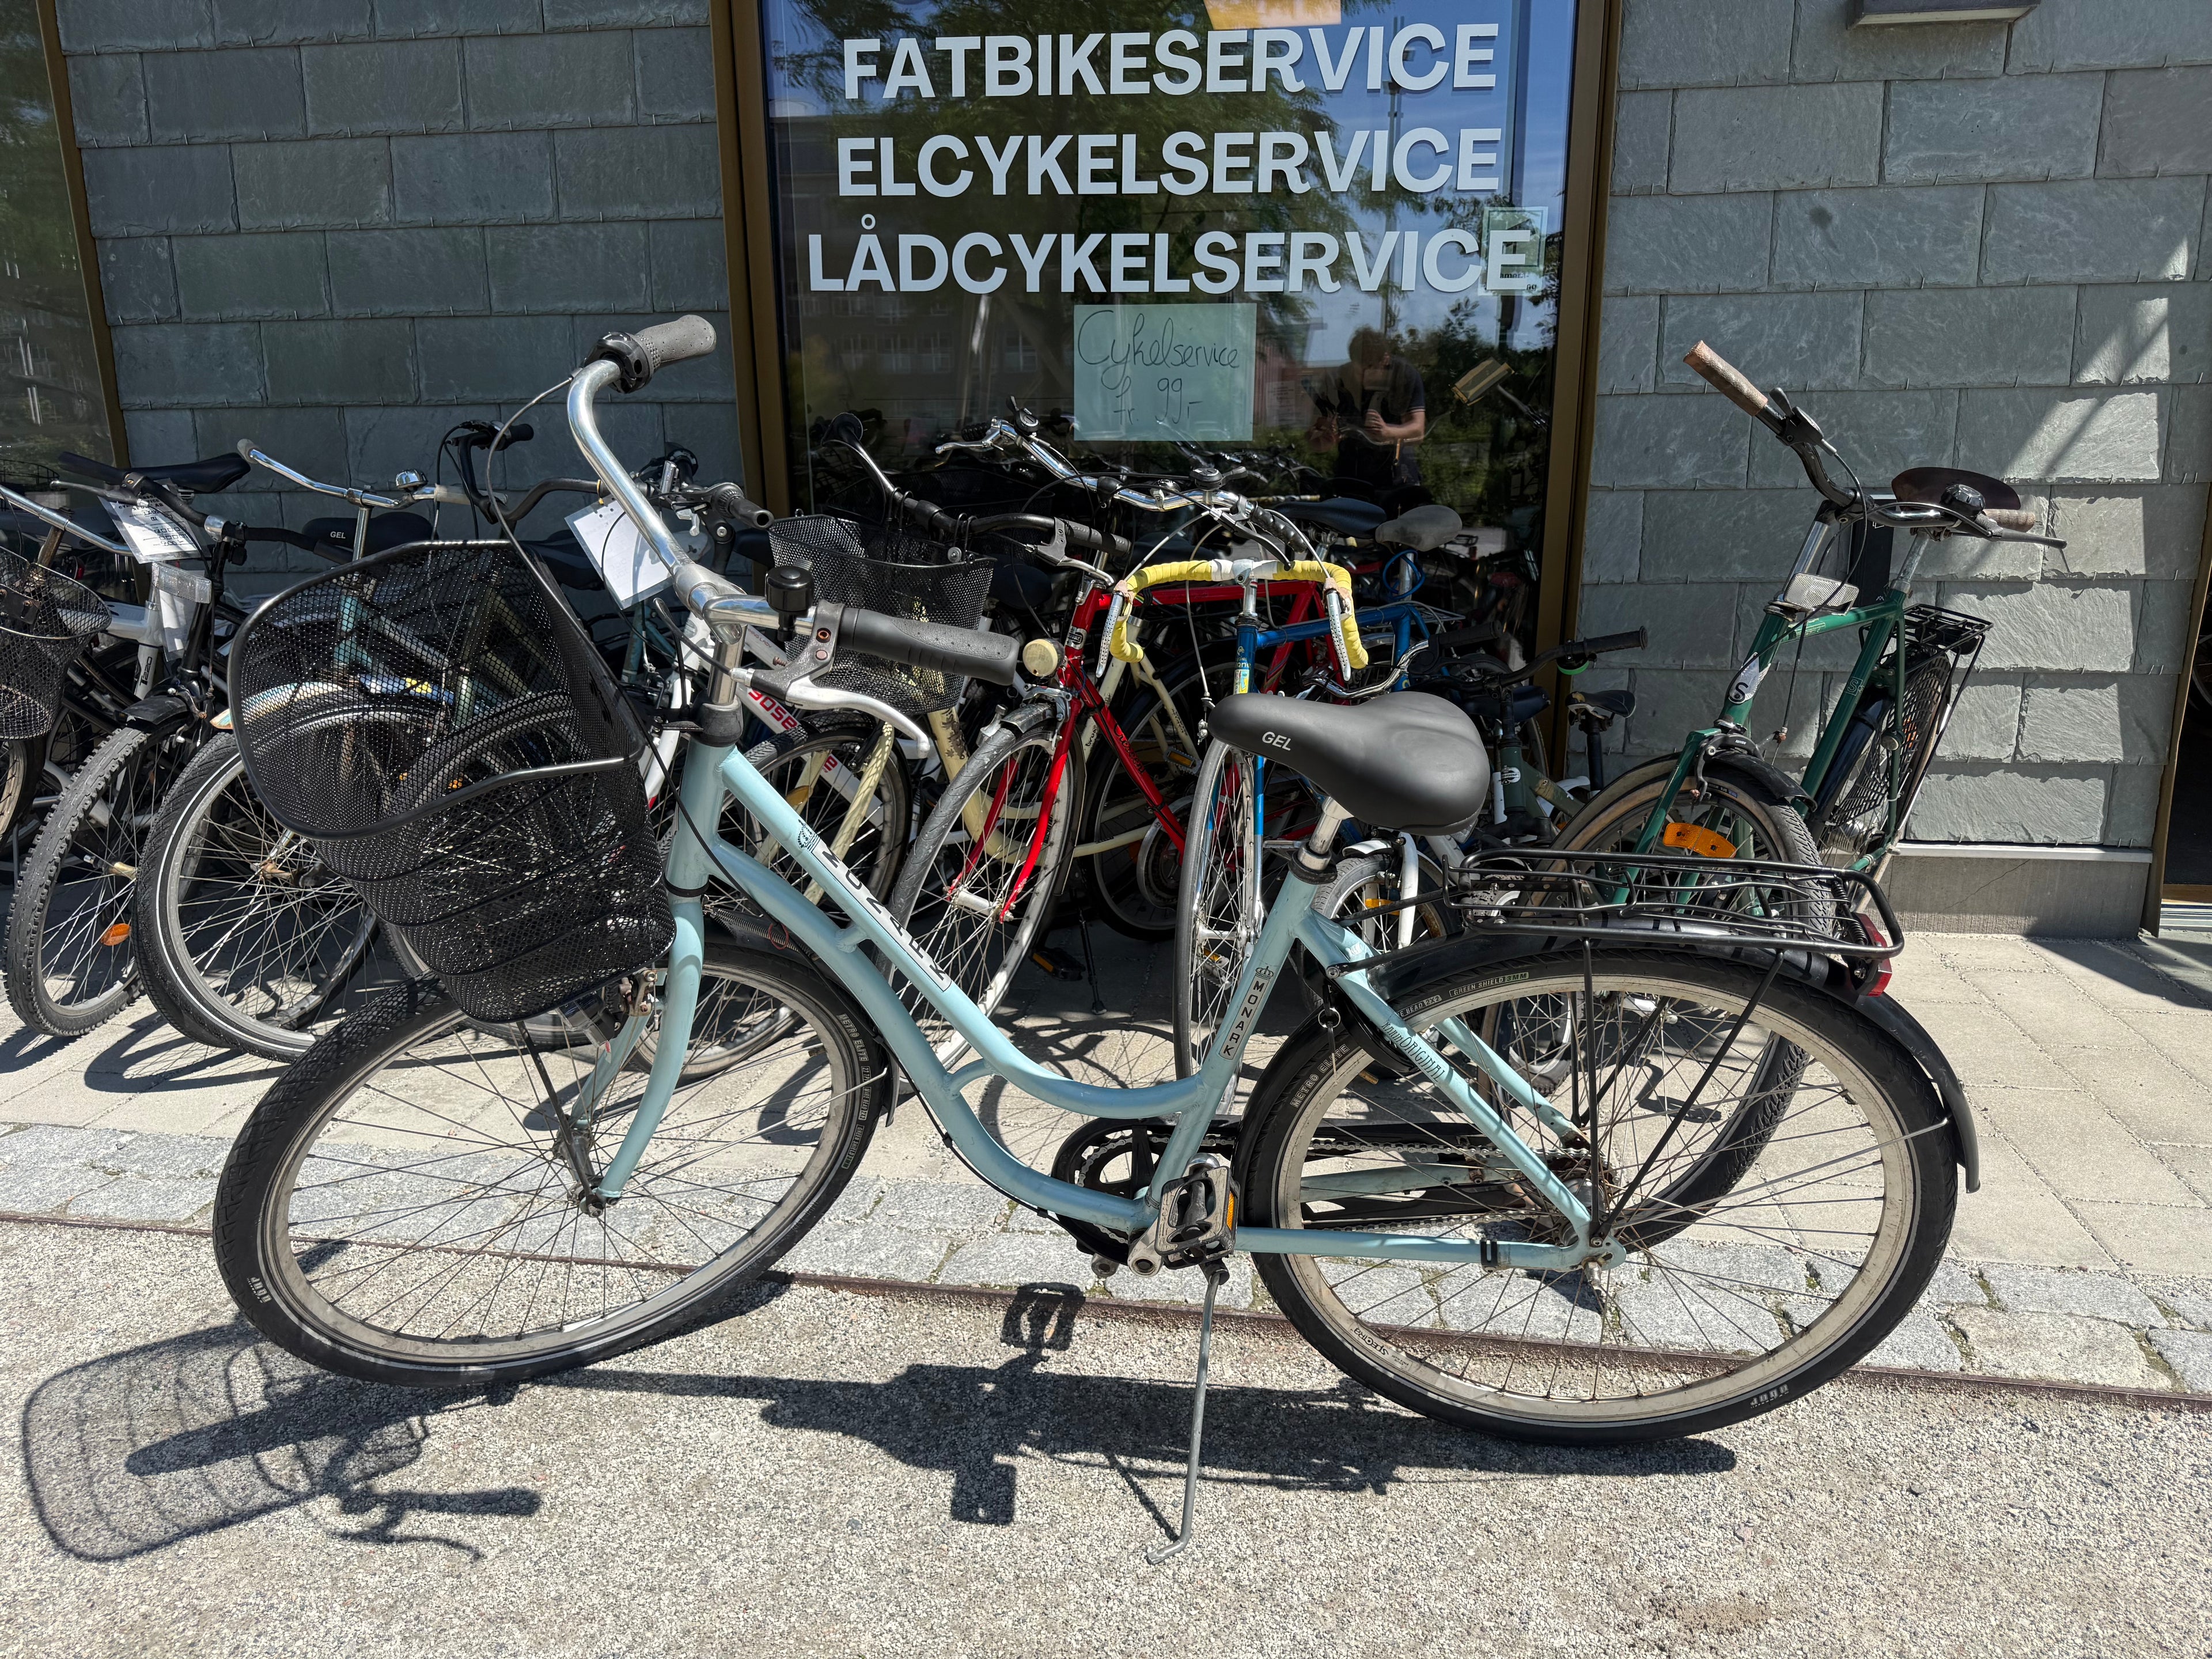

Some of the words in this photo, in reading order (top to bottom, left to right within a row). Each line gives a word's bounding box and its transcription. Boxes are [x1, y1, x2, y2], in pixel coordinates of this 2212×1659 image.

[843, 23, 1499, 100] FATBIKESERVICE
[838, 127, 1502, 198] ELCYKELSERVICE
[808, 214, 1531, 294] LÅDCYKELSERVICE
[1078, 309, 1240, 390] Cykelservice
[330, 531, 346, 539] GEL
[139, 656, 153, 686] T220
[1262, 731, 1291, 751] GEL
[822, 851, 946, 981] MONARK
[1454, 984, 1476, 996] GREEN
[1478, 977, 1504, 988] SHIELD
[836, 1013, 860, 1037] METRO
[853, 1039, 869, 1061] ELITE
[1223, 980, 1266, 1056] MONARK
[1382, 1022, 1404, 1043] KARIN
[1399, 1037, 1445, 1082] ORIGINAL
[1290, 1074, 1319, 1108] METRO
